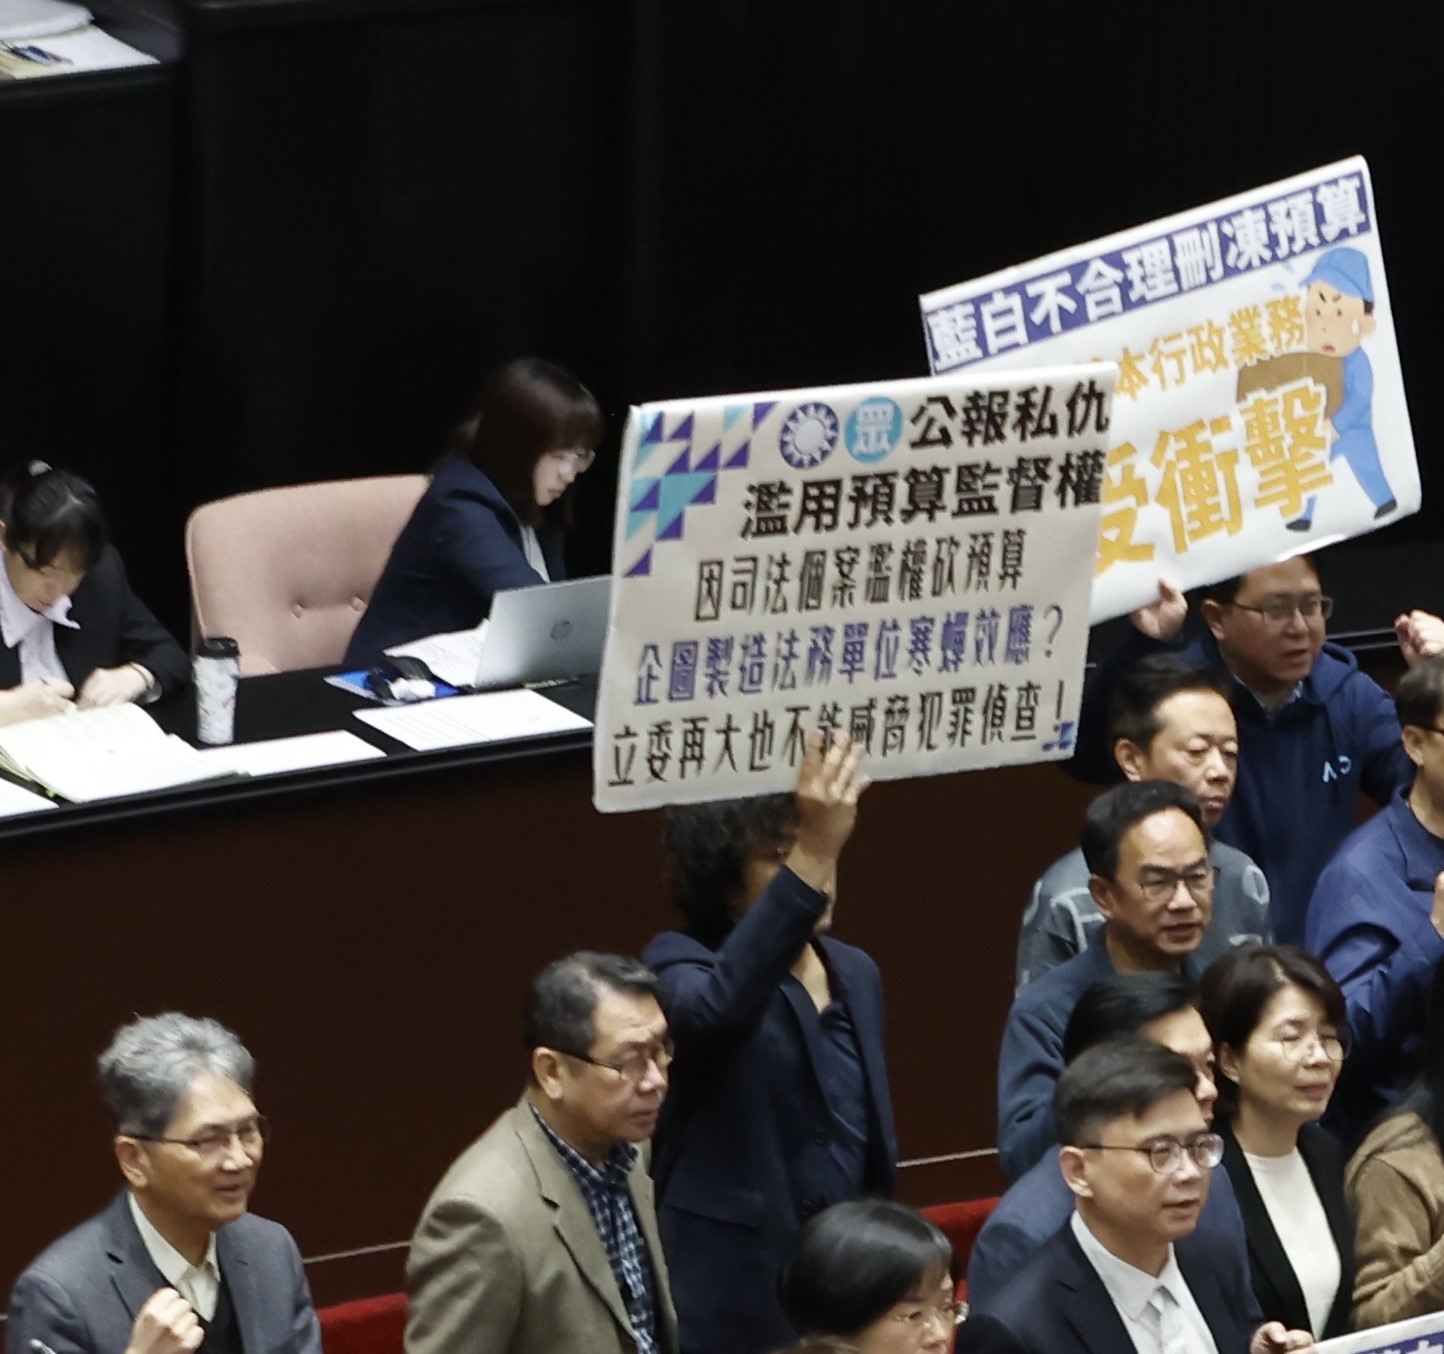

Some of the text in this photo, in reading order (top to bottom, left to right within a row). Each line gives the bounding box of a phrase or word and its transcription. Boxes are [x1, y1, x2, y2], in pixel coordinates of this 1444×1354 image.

[927, 179, 1366, 368] 藍白不合理刪凍預算
[1086, 295, 1306, 401] 本行政業務
[909, 380, 1109, 449] 公報私仇
[741, 451, 1106, 540] 濫用預算監督權
[695, 529, 1027, 622] 因司法個案濫權砍預算
